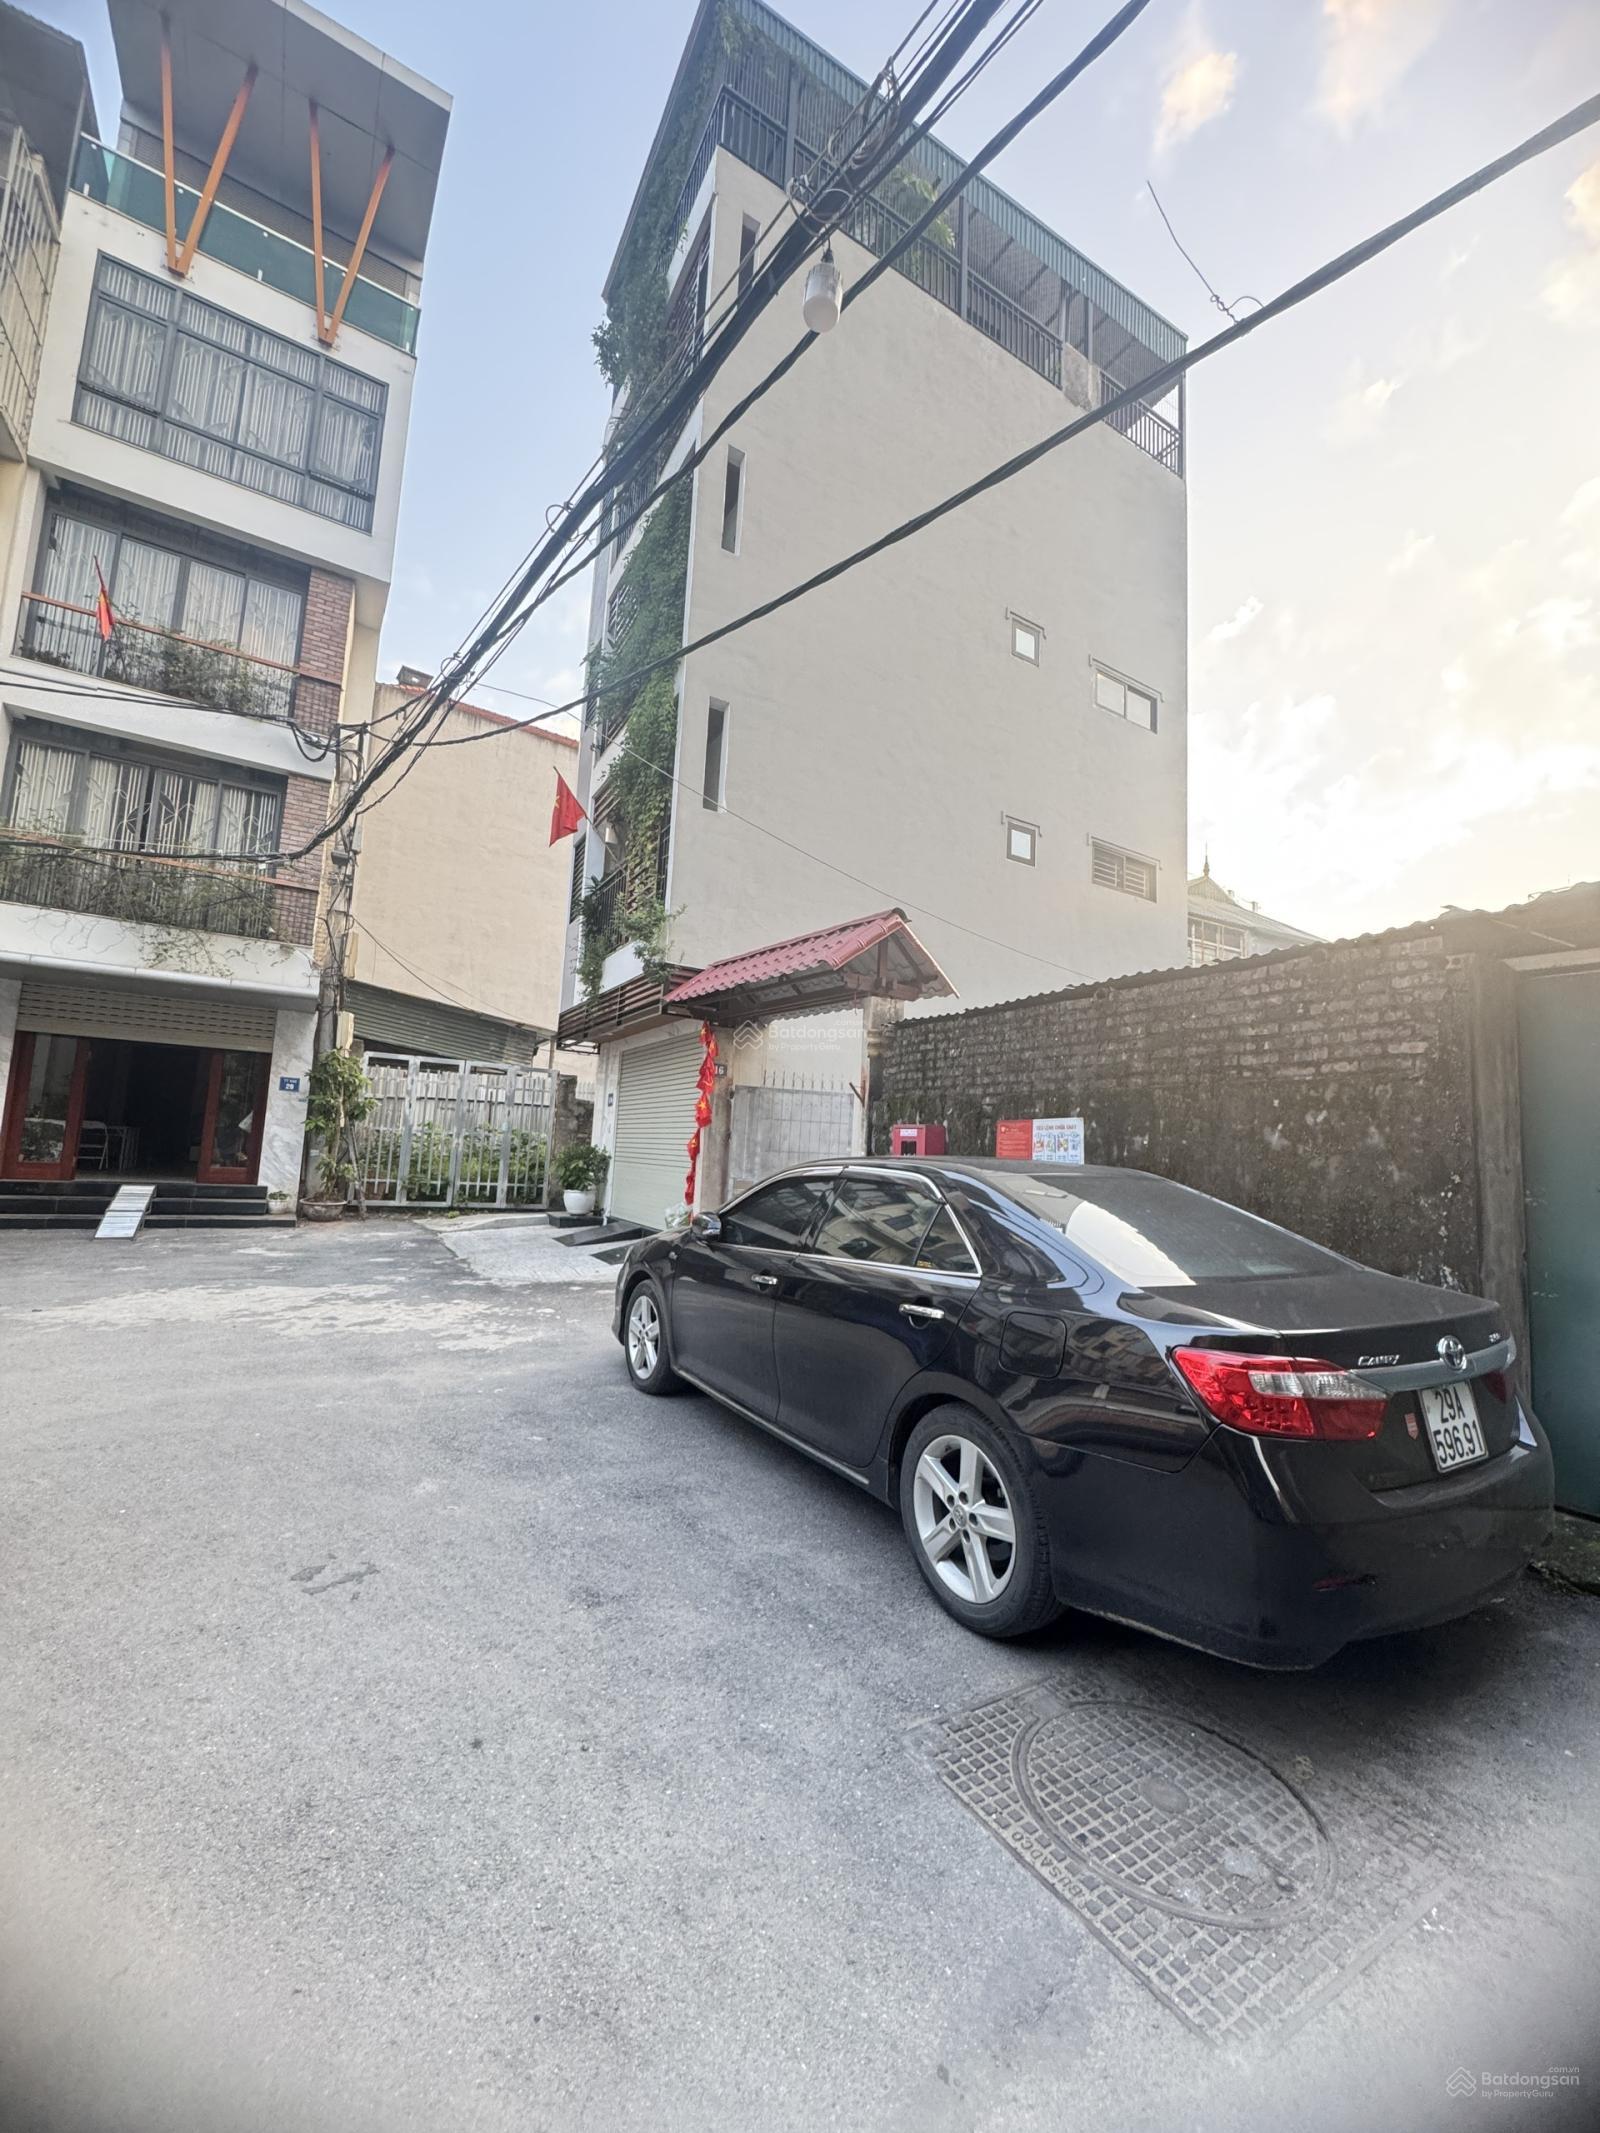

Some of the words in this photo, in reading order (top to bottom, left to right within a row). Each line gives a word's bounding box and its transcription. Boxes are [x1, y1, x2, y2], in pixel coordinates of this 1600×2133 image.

[1434, 1386, 1466, 1424] 29A
[1432, 1420, 1484, 1465] 596.91
[1011, 1831, 1083, 1897] BUSADCO
